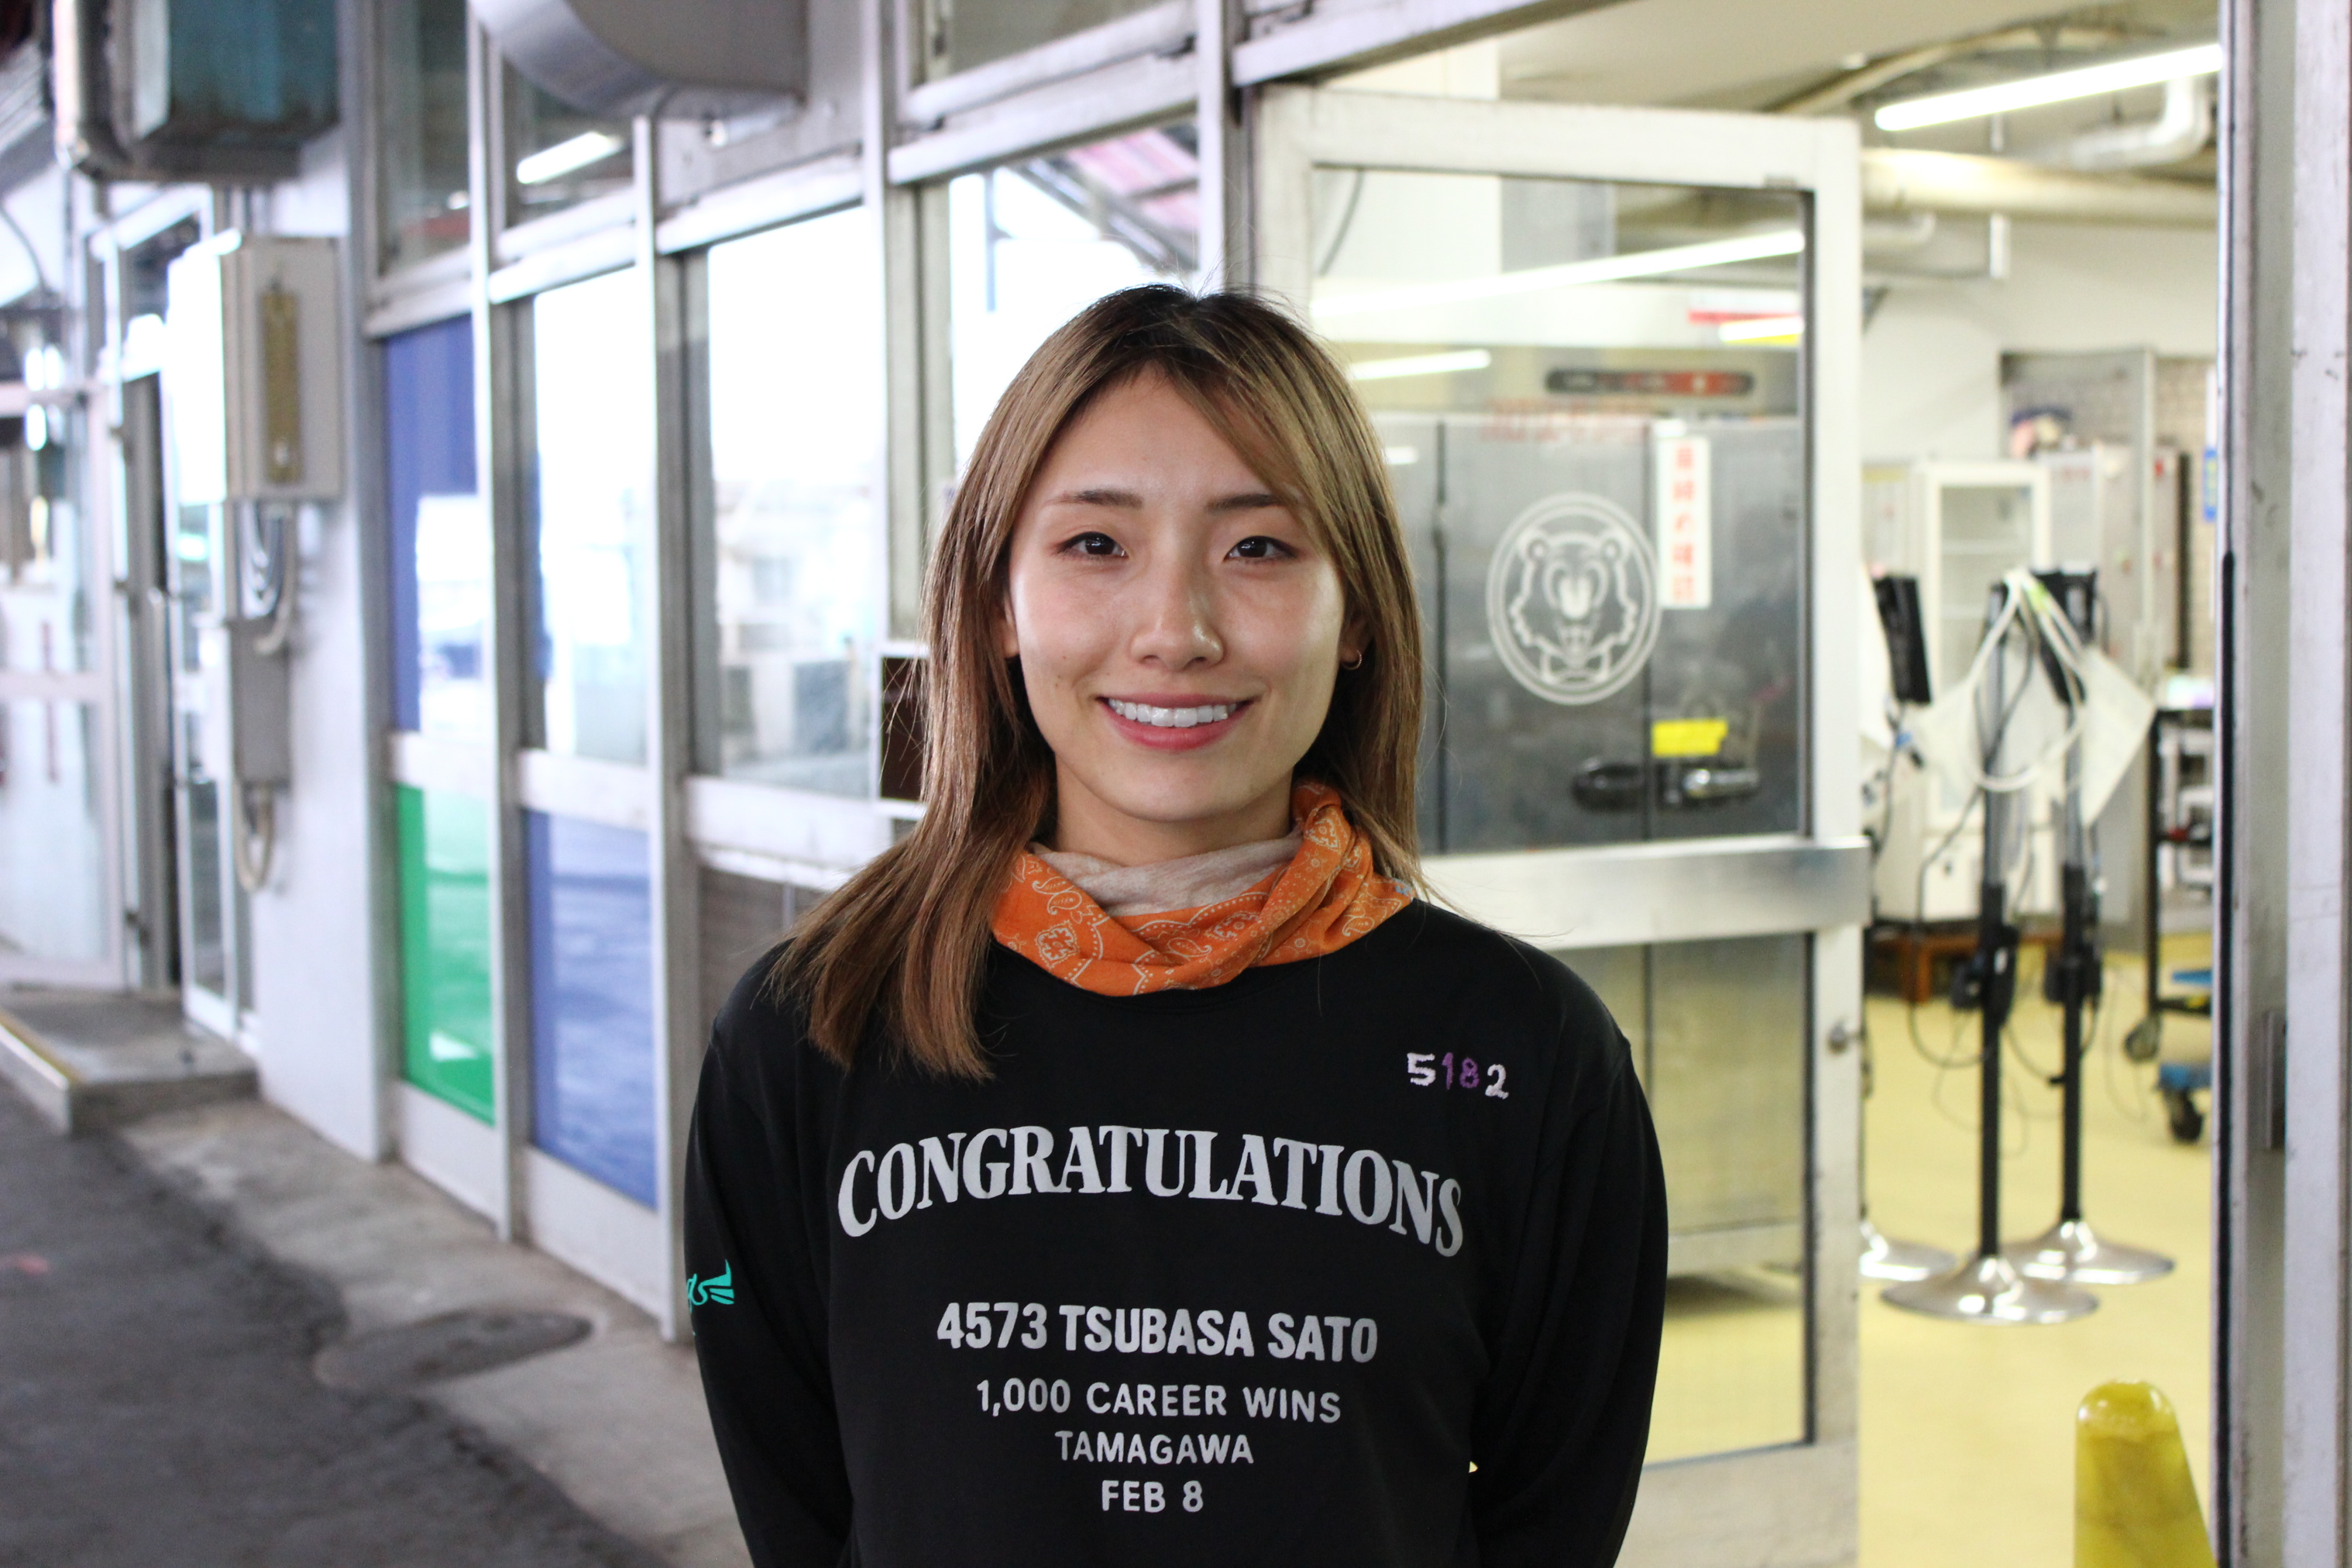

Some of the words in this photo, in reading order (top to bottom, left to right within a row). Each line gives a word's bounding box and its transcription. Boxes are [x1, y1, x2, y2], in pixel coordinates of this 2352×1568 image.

[1406, 1052, 1509, 1100] 5182
[837, 1125, 1463, 1258] CONGRATULATIONS
[937, 1302, 1047, 1350] 4573
[1058, 1305, 1255, 1357] TSUBASA
[1267, 1312, 1378, 1363] SATO
[976, 1377, 1071, 1417] 1,000
[1086, 1381, 1227, 1417] CAREER
[1242, 1387, 1341, 1424] WINS
[1054, 1430, 1254, 1465] TAMAGAWA
[1101, 1480, 1166, 1513] FEB
[1182, 1480, 1204, 1513] 8
